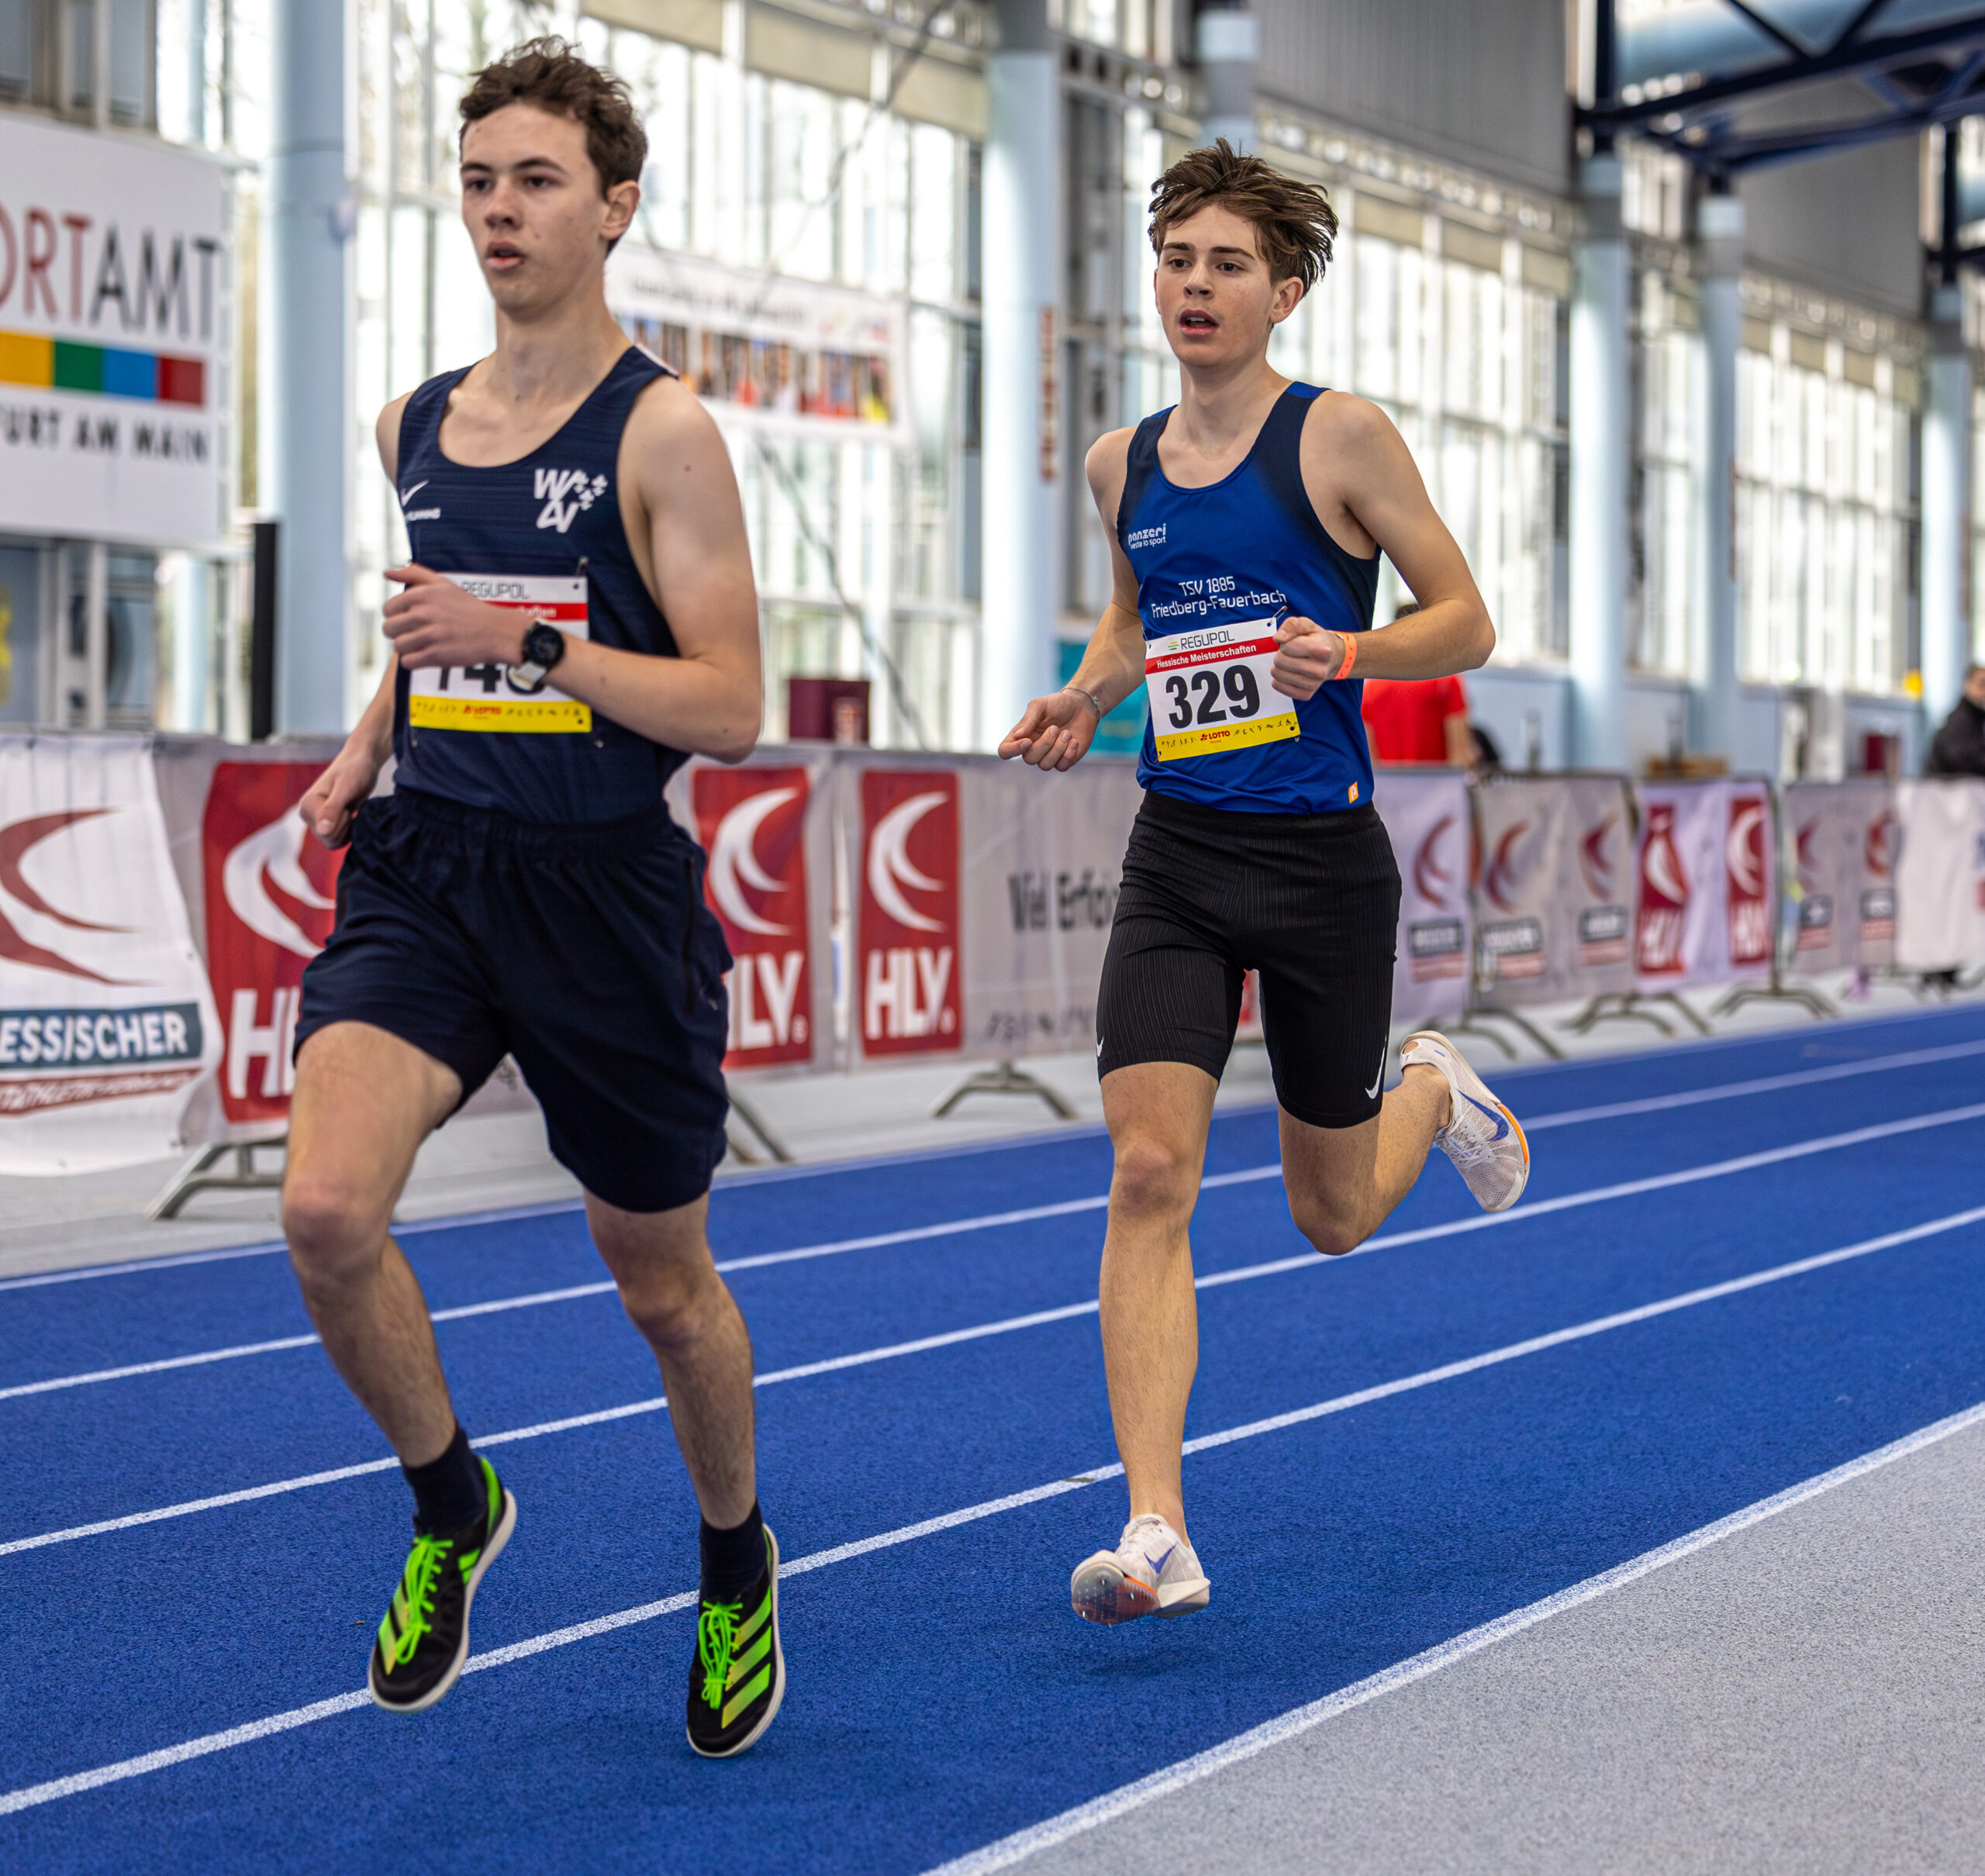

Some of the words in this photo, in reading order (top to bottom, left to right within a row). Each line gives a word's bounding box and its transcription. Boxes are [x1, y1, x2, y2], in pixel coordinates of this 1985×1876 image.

[0, 402, 60, 447] URT
[131, 419, 209, 462] MAIN
[1127, 522, 1166, 546] panzeri
[1131, 541, 1143, 550] veste
[1149, 536, 1166, 547] sport
[1179, 580, 1203, 596] TSV
[1206, 576, 1235, 593] 1885
[1151, 589, 1287, 619] Friedberg-Fauerbach
[1180, 629, 1235, 650] REGUPOL
[1157, 657, 1189, 669] Hessische
[1190, 645, 1257, 663] Meisterschaften
[1165, 664, 1260, 729] 329
[1208, 730, 1231, 740] LOTTO
